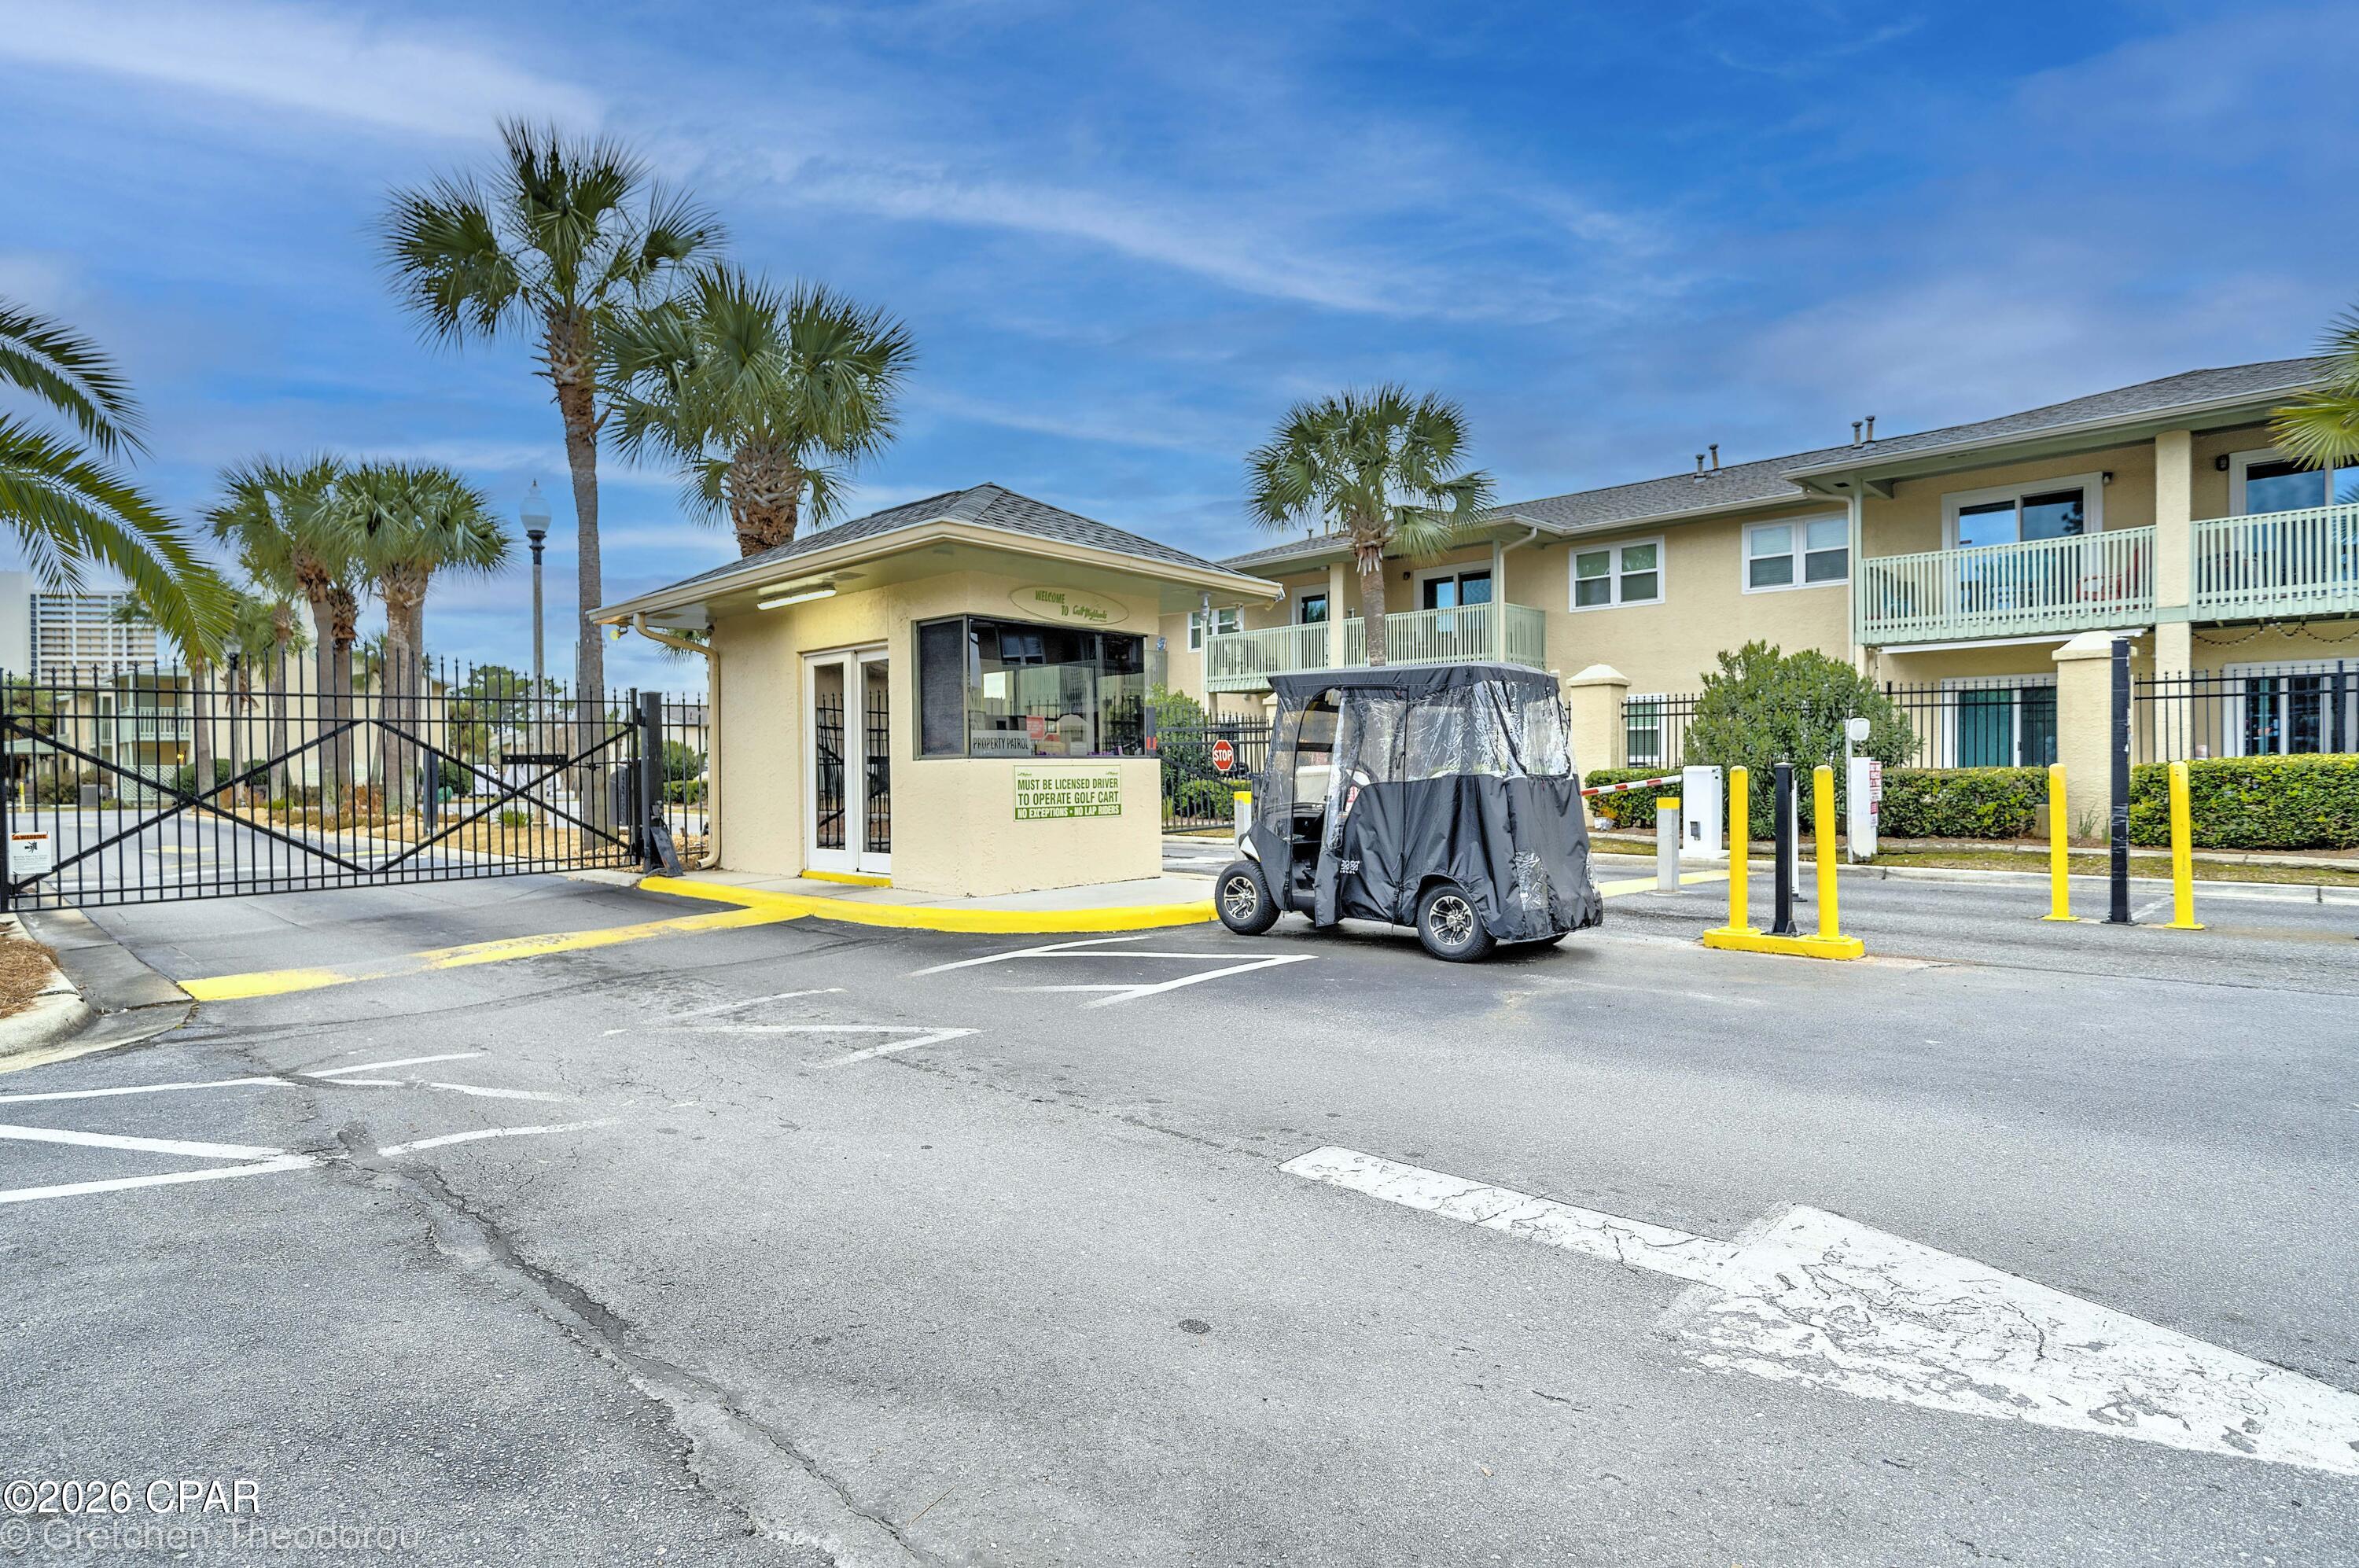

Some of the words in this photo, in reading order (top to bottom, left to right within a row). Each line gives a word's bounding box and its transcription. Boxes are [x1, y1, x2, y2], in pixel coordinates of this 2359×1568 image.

[1035, 590, 1065, 604] WELCOME
[1062, 605, 1069, 616] TO
[973, 737, 1006, 749] PROPERTY
[1007, 737, 1029, 749] PATROL
[1213, 749, 1233, 761] STOP
[1018, 779, 1040, 790] MUST
[1043, 778, 1052, 790] BE
[1055, 778, 1090, 790] LICENSED
[1092, 778, 1118, 789] DRIVER
[1018, 793, 1029, 805] TO
[1033, 793, 1071, 805] OPERATE
[1074, 791, 1095, 804] GOLF
[1098, 791, 1118, 803] CART
[1018, 808, 1027, 819] NO
[1029, 807, 1068, 818] EXCEPTIONS
[1074, 806, 1083, 816] NO
[1085, 806, 1097, 815] LAP
[1098, 805, 1119, 815] RIDERS
